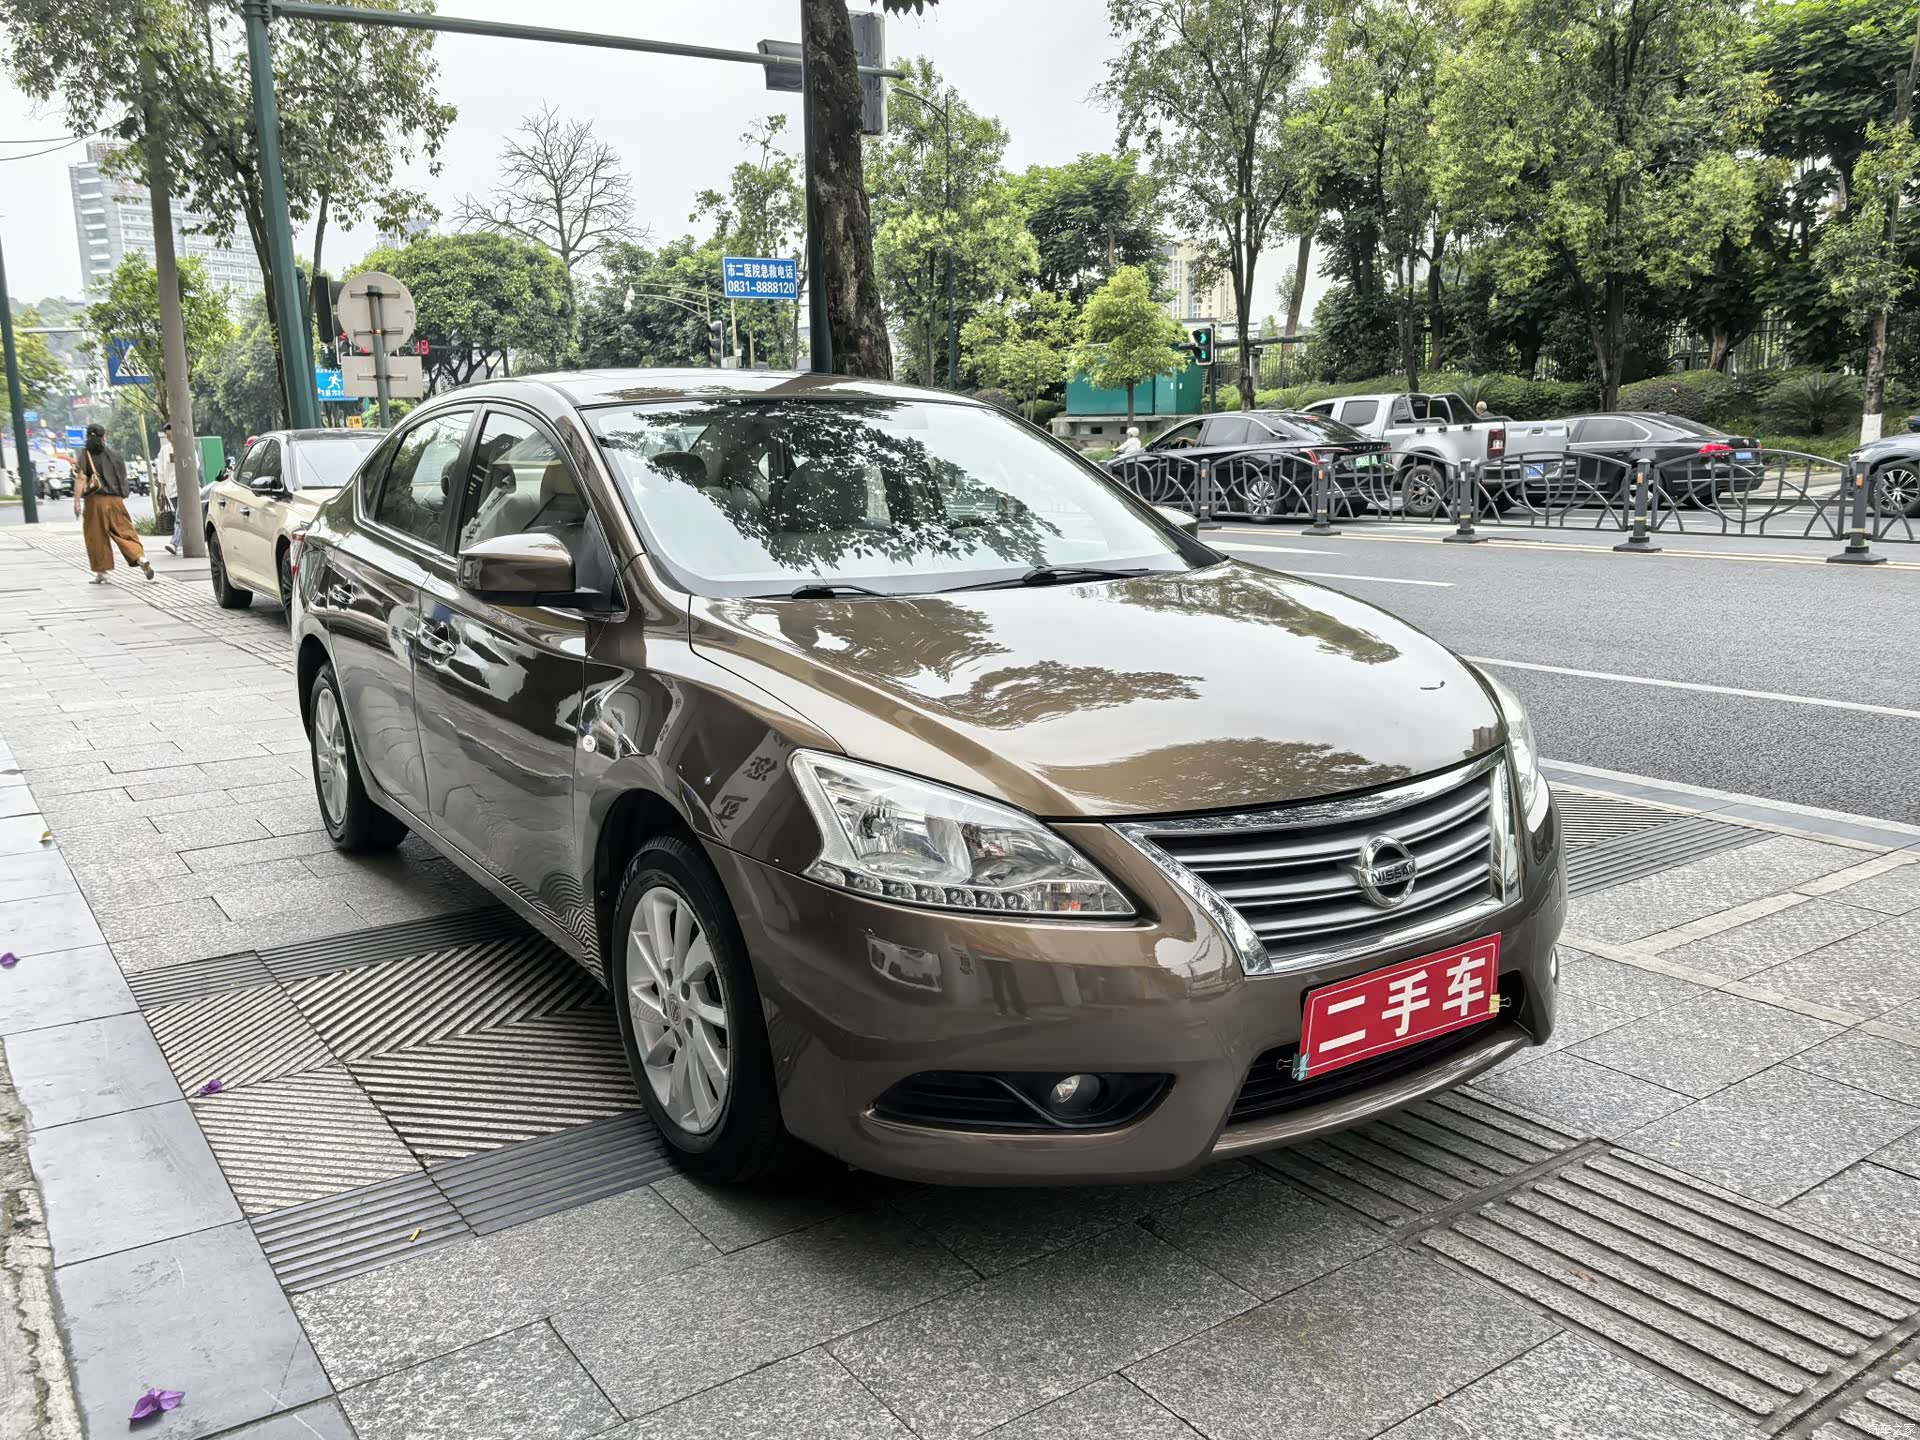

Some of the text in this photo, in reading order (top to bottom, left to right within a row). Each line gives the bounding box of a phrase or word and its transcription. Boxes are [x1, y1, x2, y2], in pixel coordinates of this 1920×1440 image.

[727, 263, 793, 279] 市二医院急救电话
[728, 281, 795, 293] 0831-8888120
[1371, 861, 1415, 883] NISSAN
[1318, 957, 1486, 1053] 二手车
